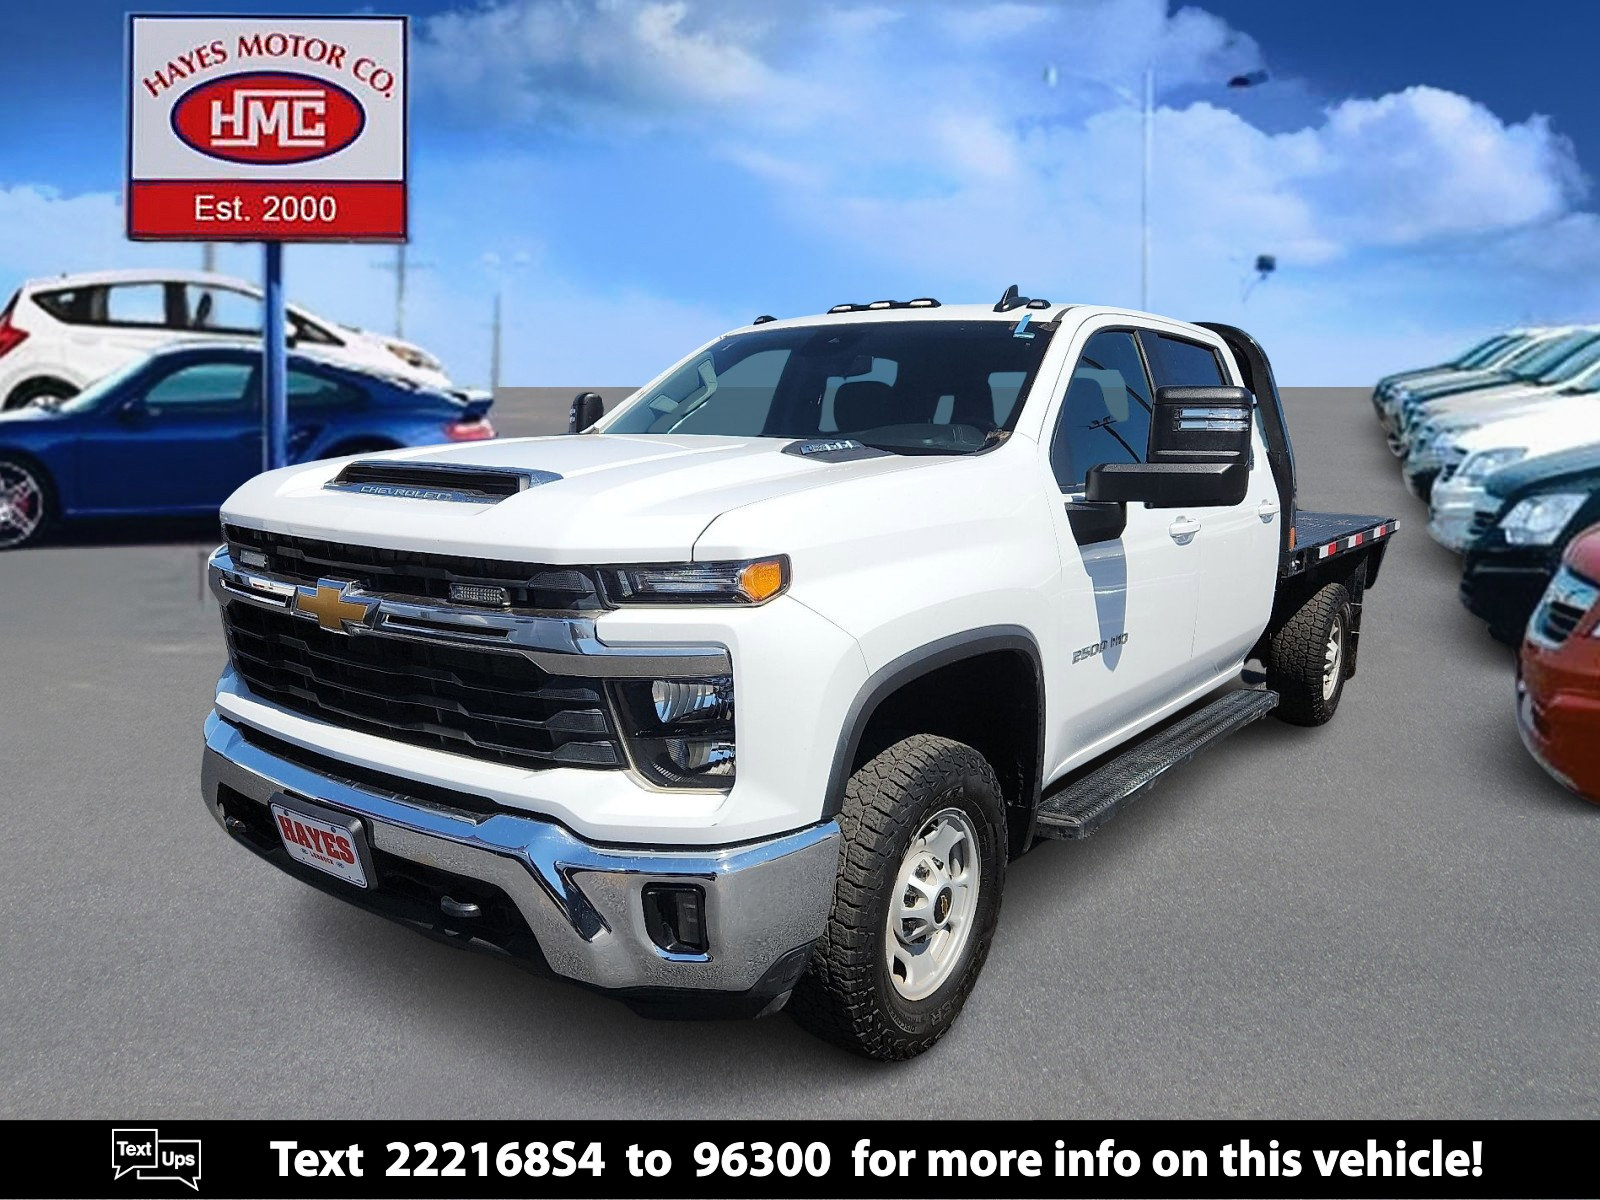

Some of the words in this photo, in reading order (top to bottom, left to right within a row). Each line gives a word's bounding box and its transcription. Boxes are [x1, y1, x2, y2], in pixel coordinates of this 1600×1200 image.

[143, 40, 228, 98] HAYES
[238, 33, 347, 70] MOTOR
[353, 58, 395, 99] CO.
[210, 88, 326, 148] HMC
[195, 194, 250, 222] Est.
[262, 195, 337, 222] 2000
[360, 485, 452, 501] CHEVROLET
[1072, 640, 1108, 665] 2500
[277, 814, 355, 865] HAYES
